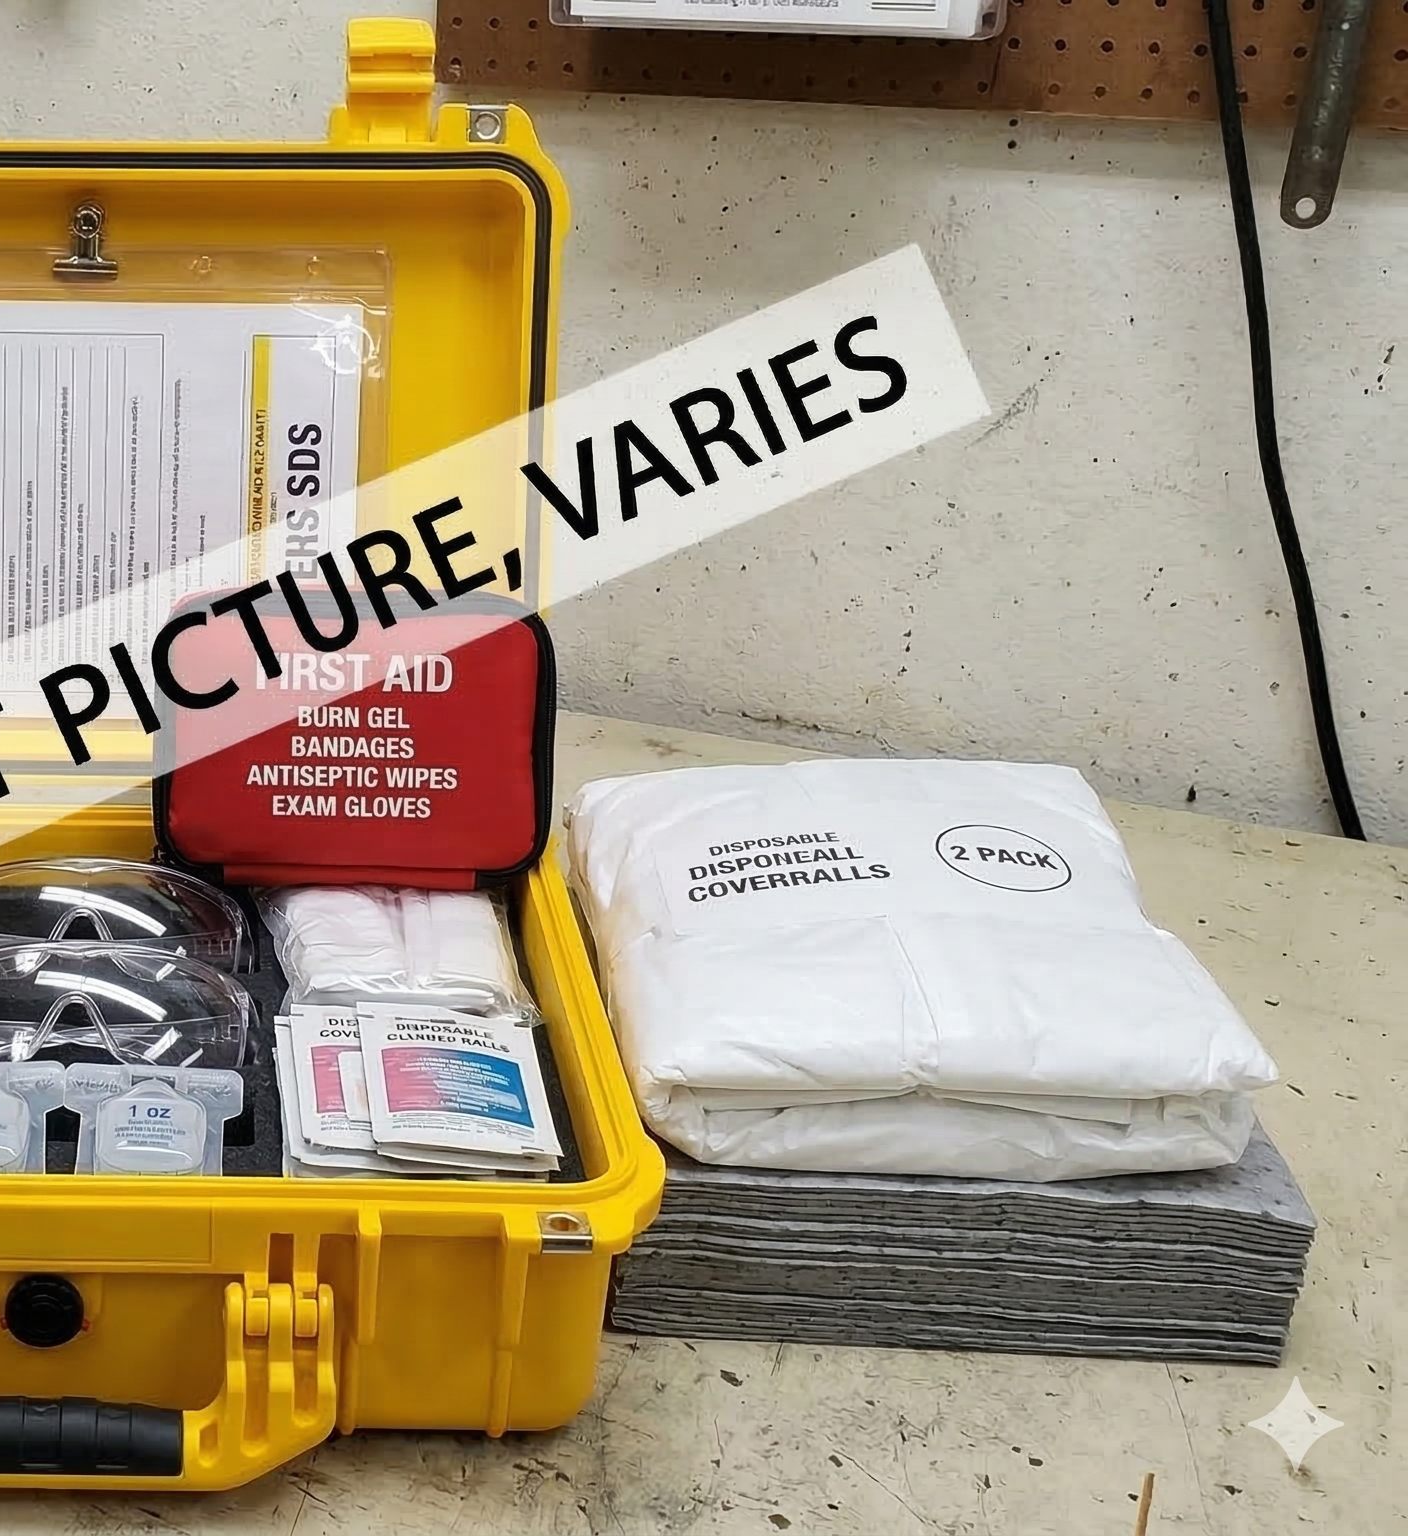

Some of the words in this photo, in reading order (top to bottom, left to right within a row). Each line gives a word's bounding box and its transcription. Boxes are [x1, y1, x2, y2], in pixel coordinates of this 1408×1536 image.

[286, 424, 322, 497] SDS
[382, 655, 454, 693] AID
[298, 707, 359, 728] BURN
[367, 708, 410, 729] GEL
[292, 737, 415, 759] BANDAGES
[246, 765, 378, 788] ANTISEPTIC
[385, 767, 458, 790] WIPES
[272, 795, 336, 817] EXAM
[344, 797, 431, 818] GLOVES
[709, 831, 839, 857] DISPOSABLE
[950, 845, 970, 861] 2
[976, 846, 1059, 871] PACK
[688, 863, 891, 902] COVERRALLS
[129, 1105, 137, 1118] 1
[147, 1107, 172, 1118] OZ
